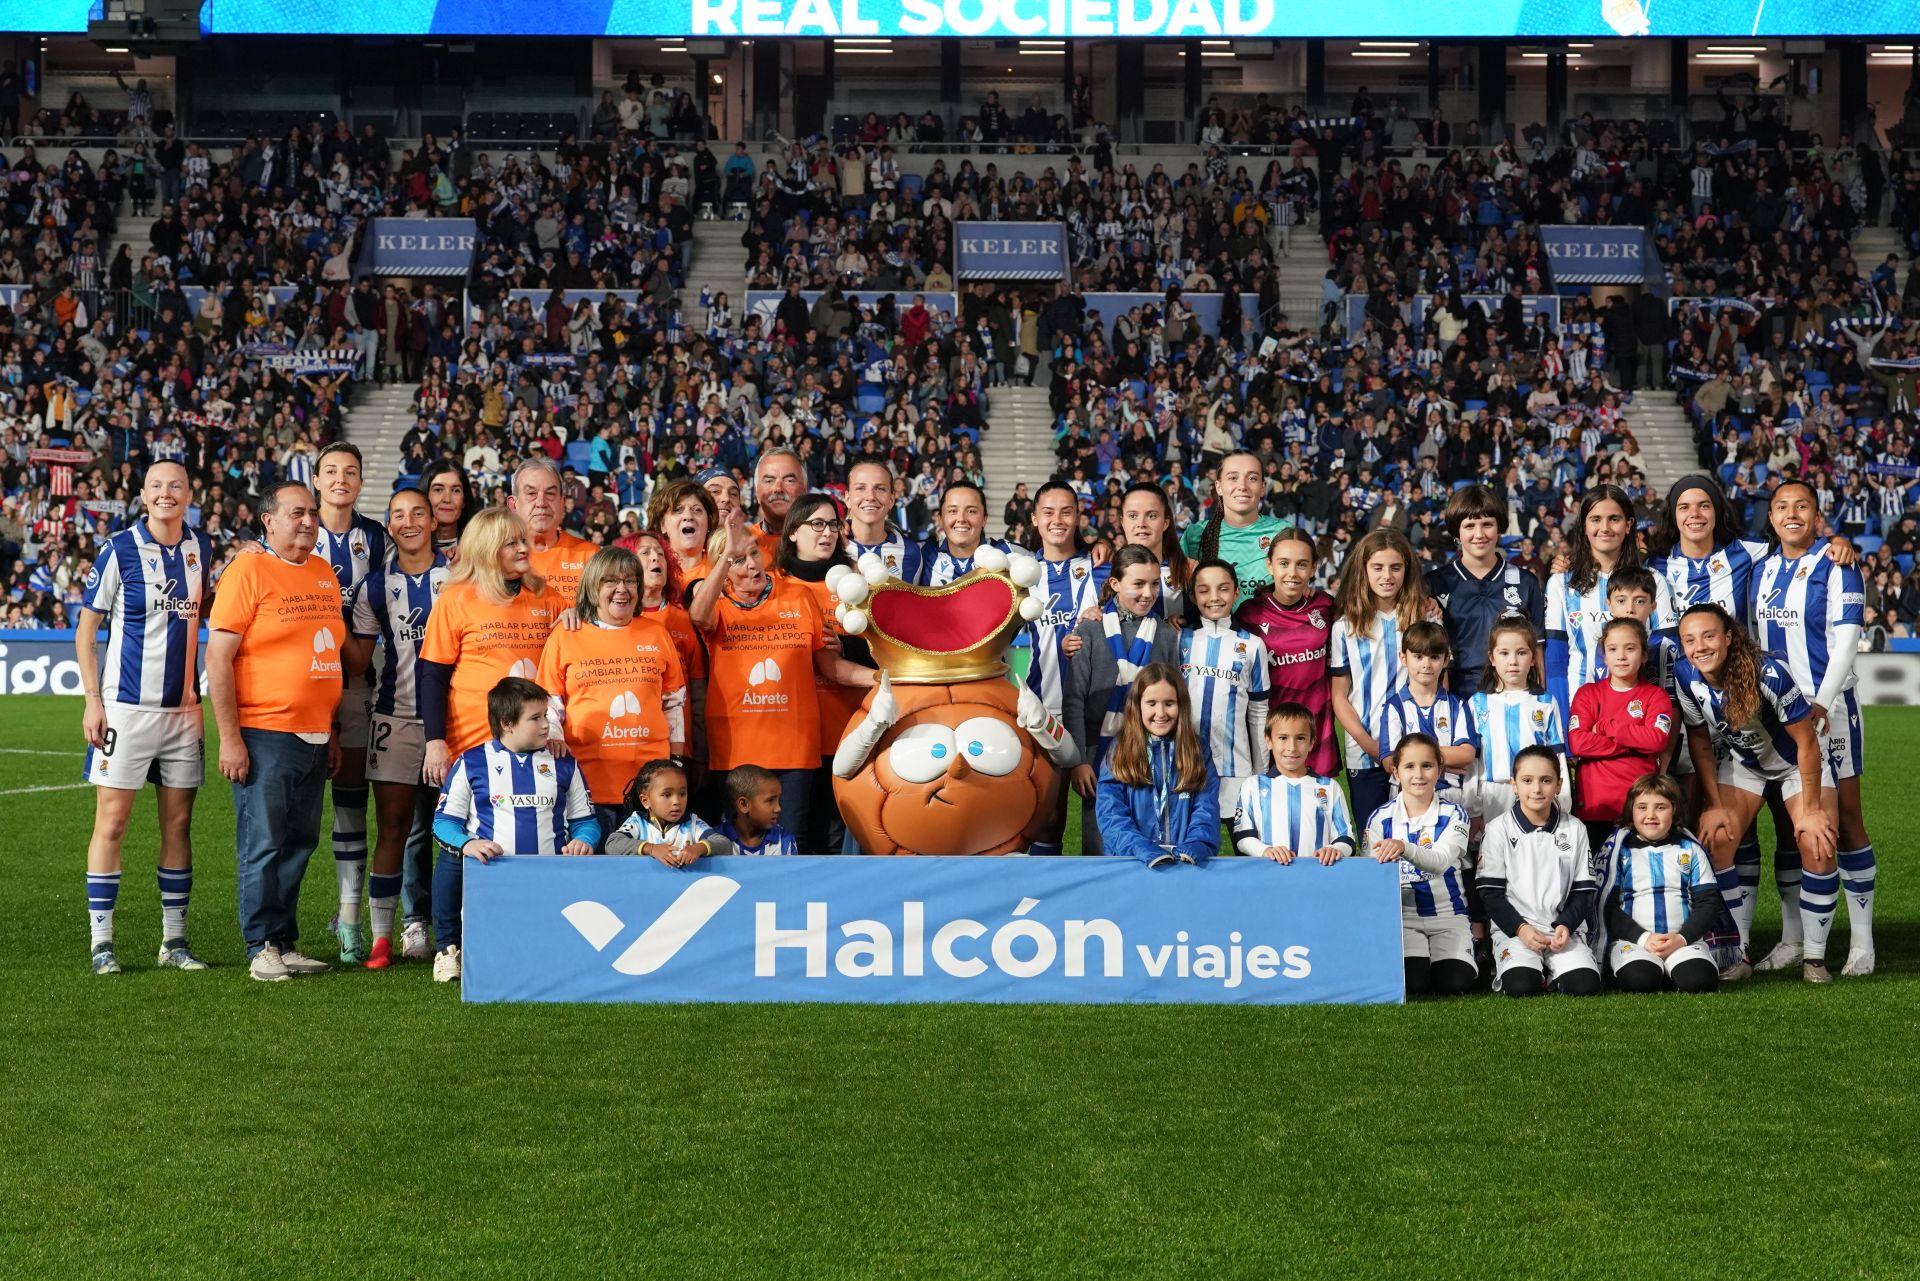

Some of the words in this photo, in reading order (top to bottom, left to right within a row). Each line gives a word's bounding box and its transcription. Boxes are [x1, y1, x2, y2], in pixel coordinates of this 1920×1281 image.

[691, 0, 879, 34] REAL
[899, 0, 1275, 35] SOCIEDAD
[378, 234, 475, 250] KELER
[960, 239, 1058, 254] KELER
[1545, 243, 1640, 258] KELER
[561, 561, 584, 570] GSK
[548, 574, 579, 582] PUEDE
[154, 597, 198, 611] Halcón
[281, 594, 316, 604] HABLAR
[179, 611, 197, 620] viajes
[277, 605, 317, 615] CAMBIAR
[779, 611, 801, 619] GSK
[1758, 606, 1798, 619] Halcón
[480, 622, 519, 630] HABLAR
[521, 622, 551, 630] PUEDE
[726, 624, 765, 632] HABLAR
[768, 623, 799, 631] PUEDE
[1779, 620, 1799, 628] viajes
[400, 628, 426, 642] Hal
[475, 632, 519, 642] CAMBIAR
[522, 633, 534, 641] LA
[720, 634, 765, 643] CAMBIAR
[782, 632, 806, 641] EPOC
[580, 657, 622, 668] HABLAR
[575, 667, 622, 680] CAMBIAR
[1196, 666, 1240, 682] YASUDA
[742, 689, 789, 705] Ábrete
[371, 720, 392, 752] 12
[602, 722, 650, 739] Ábrete
[101, 727, 118, 758] 9
[510, 795, 554, 806] YASUDA
[754, 896, 1124, 978] Halcón
[1136, 930, 1312, 988] viajes
